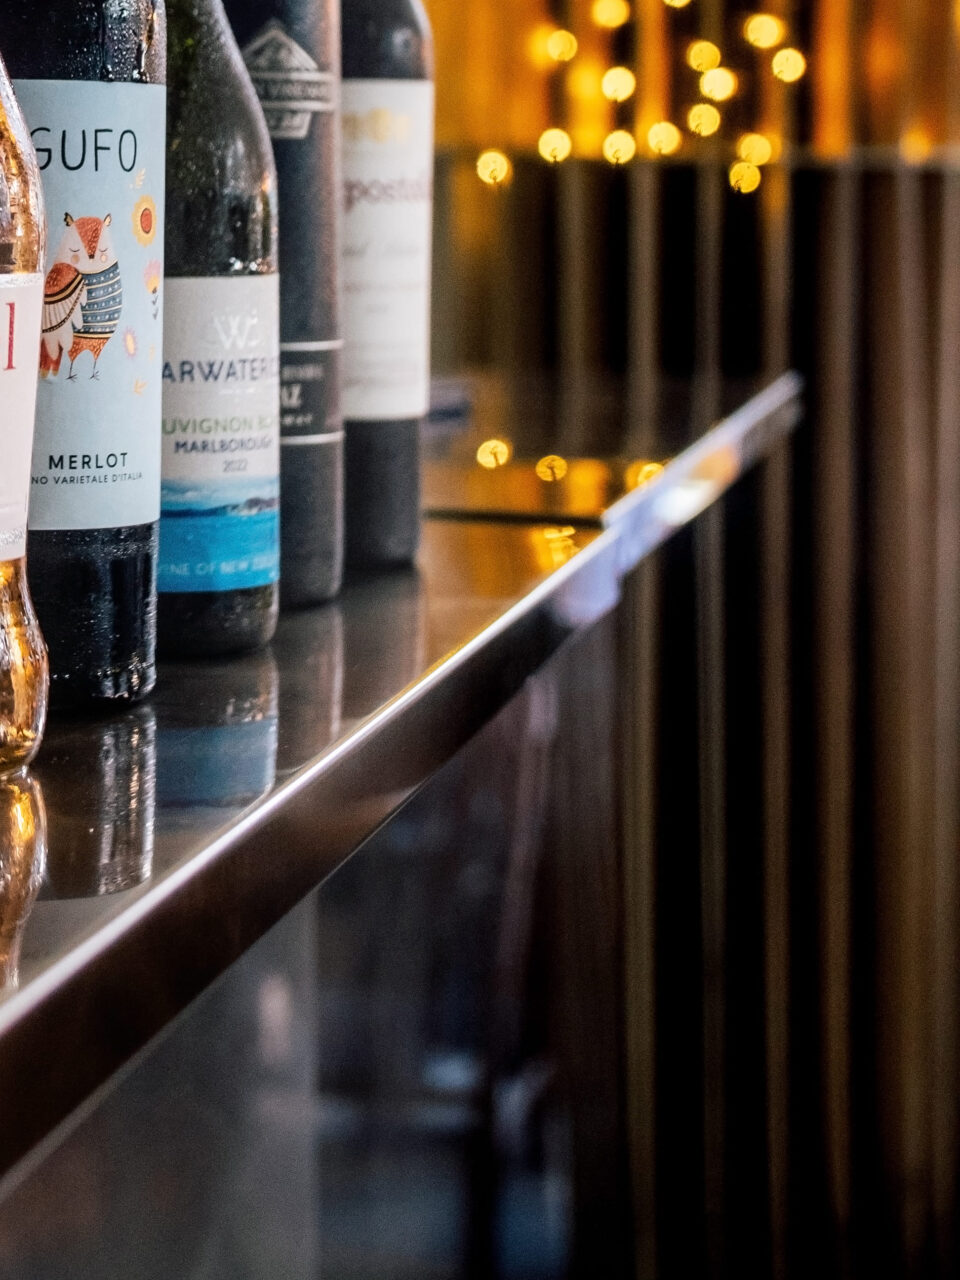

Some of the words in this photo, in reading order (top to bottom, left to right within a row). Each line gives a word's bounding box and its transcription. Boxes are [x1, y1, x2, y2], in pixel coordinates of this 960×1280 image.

[29, 126, 137, 173] GUFO
[161, 357, 277, 384] ARWATER
[48, 452, 128, 470] MERLOT
[53, 474, 108, 485] VARIETALE
